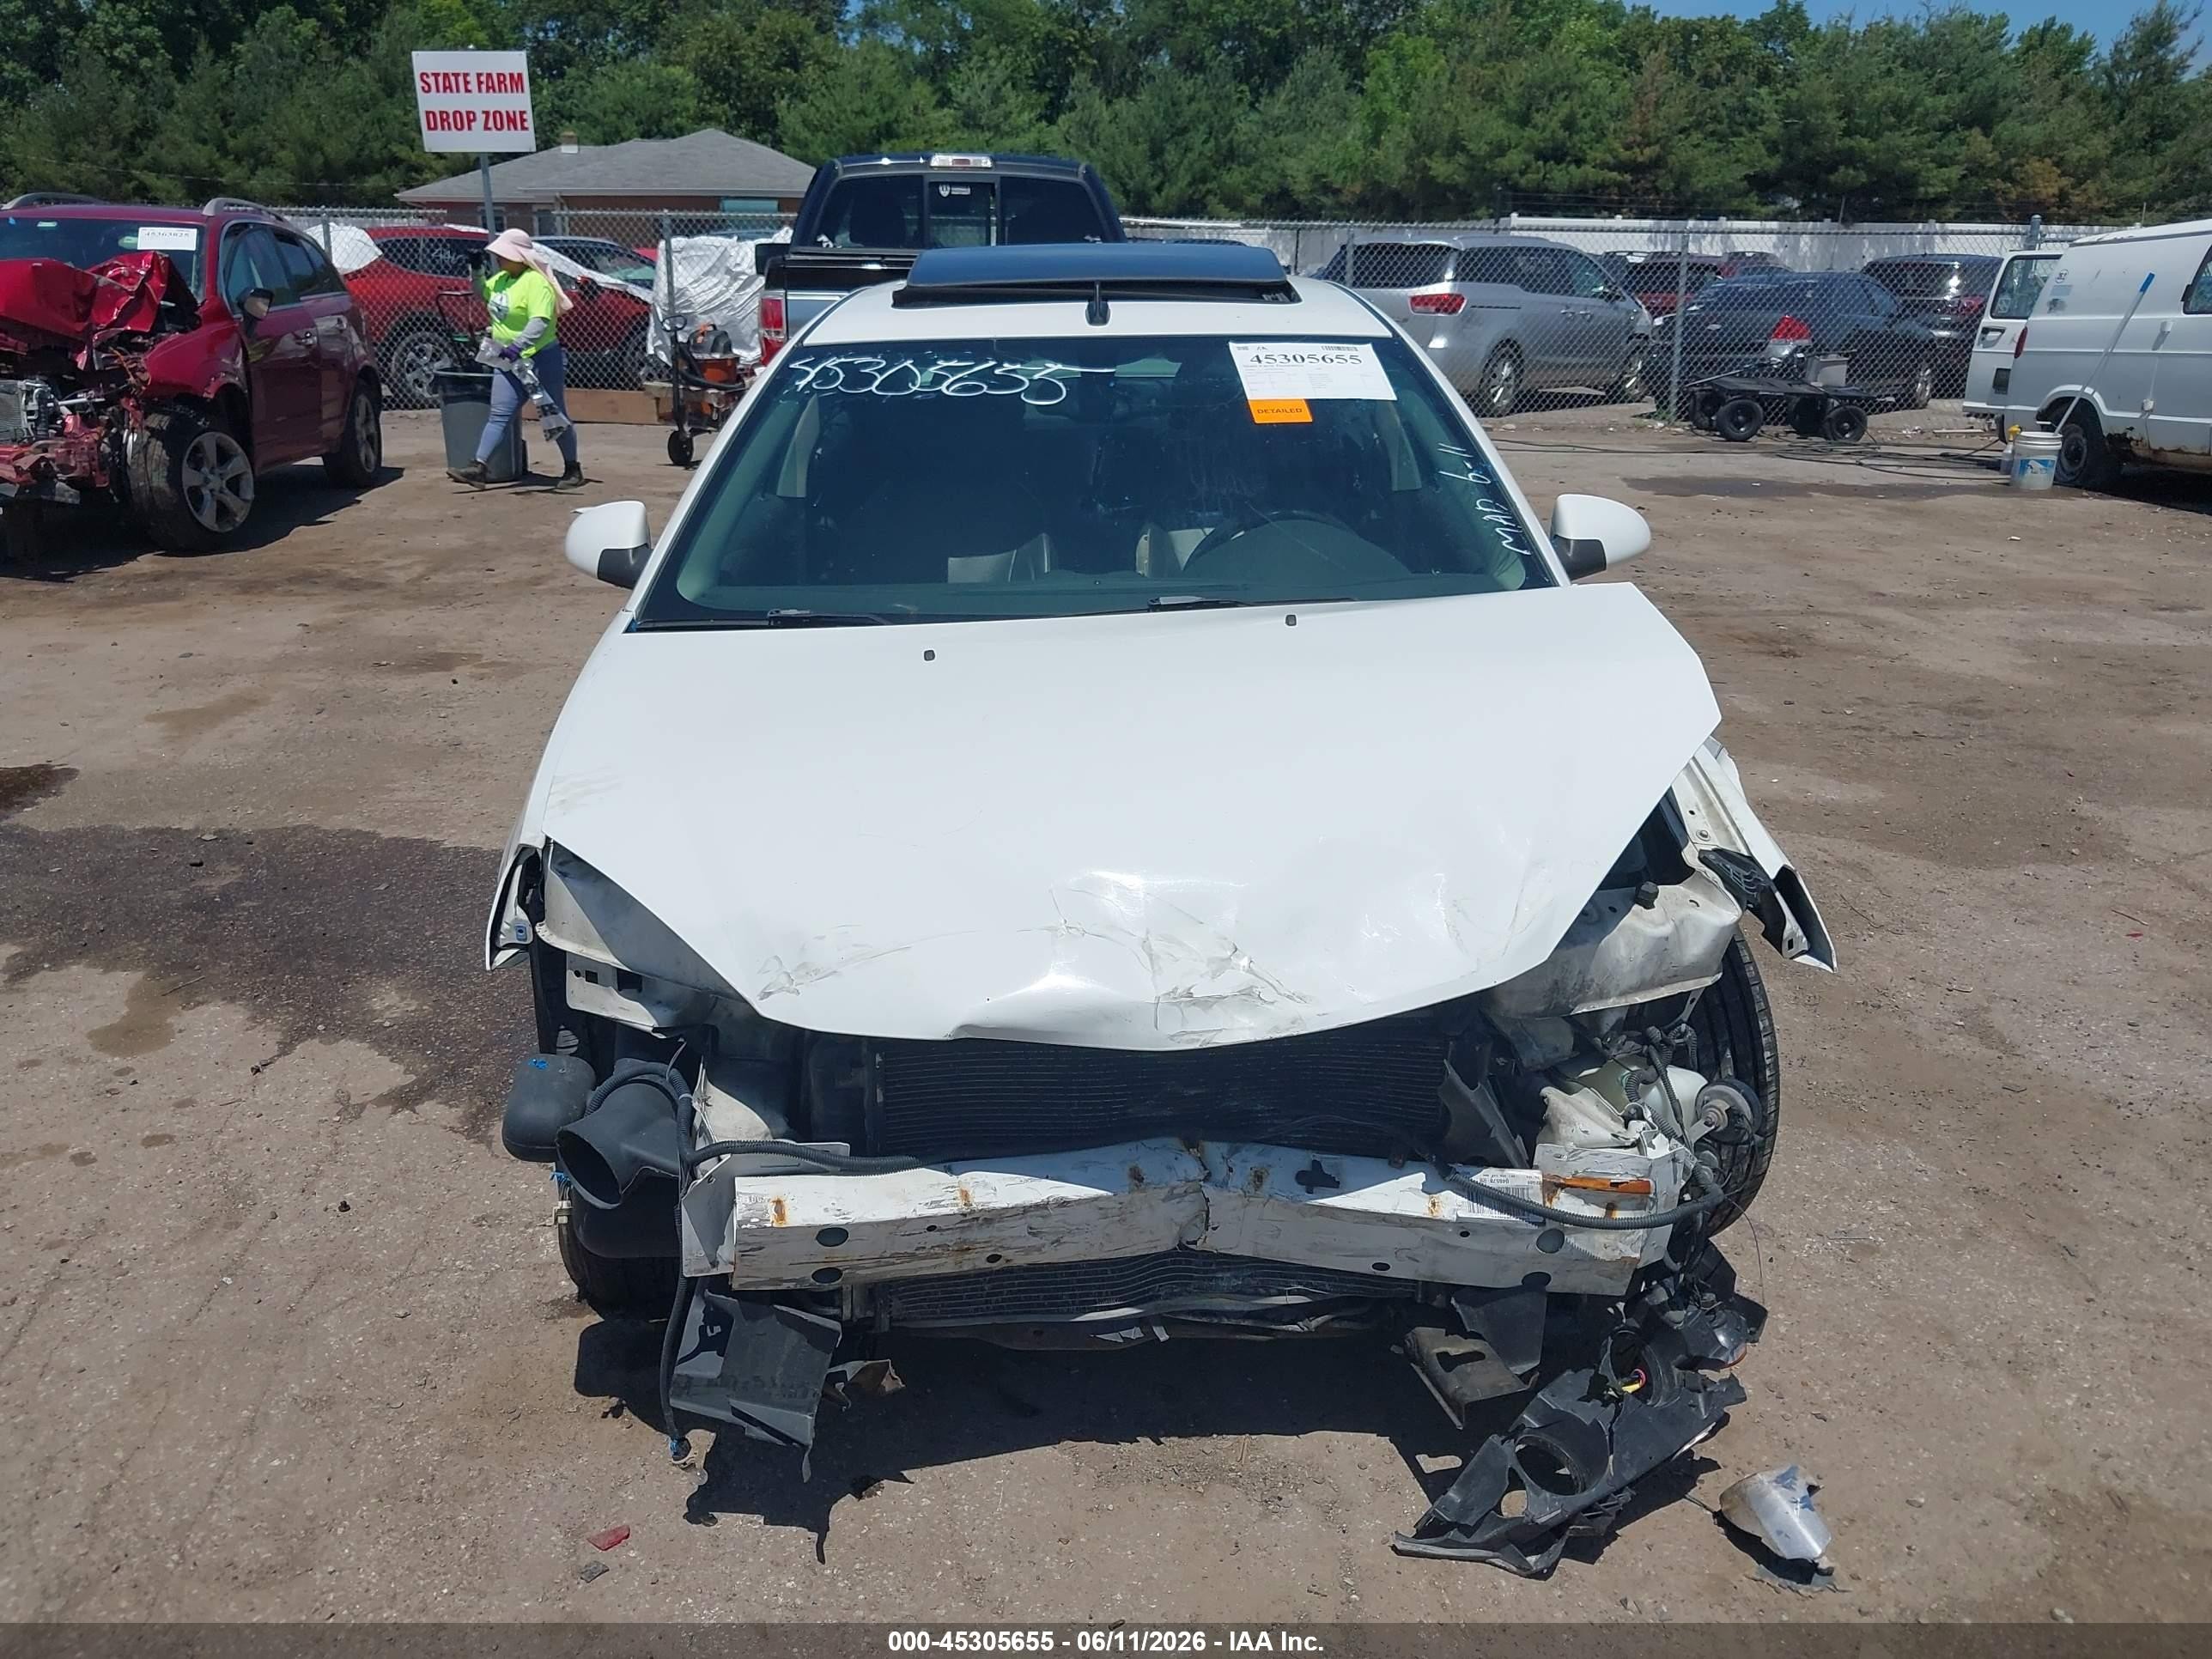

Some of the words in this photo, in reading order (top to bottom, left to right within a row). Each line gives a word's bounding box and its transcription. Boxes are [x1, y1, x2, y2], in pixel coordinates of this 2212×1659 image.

[419, 71, 472, 94] STATE
[476, 71, 526, 94] FARM
[425, 109, 477, 132] DROP
[482, 109, 530, 132] ZONE
[1249, 353, 1363, 365] 45305655
[789, 356, 1116, 405] 45305655
